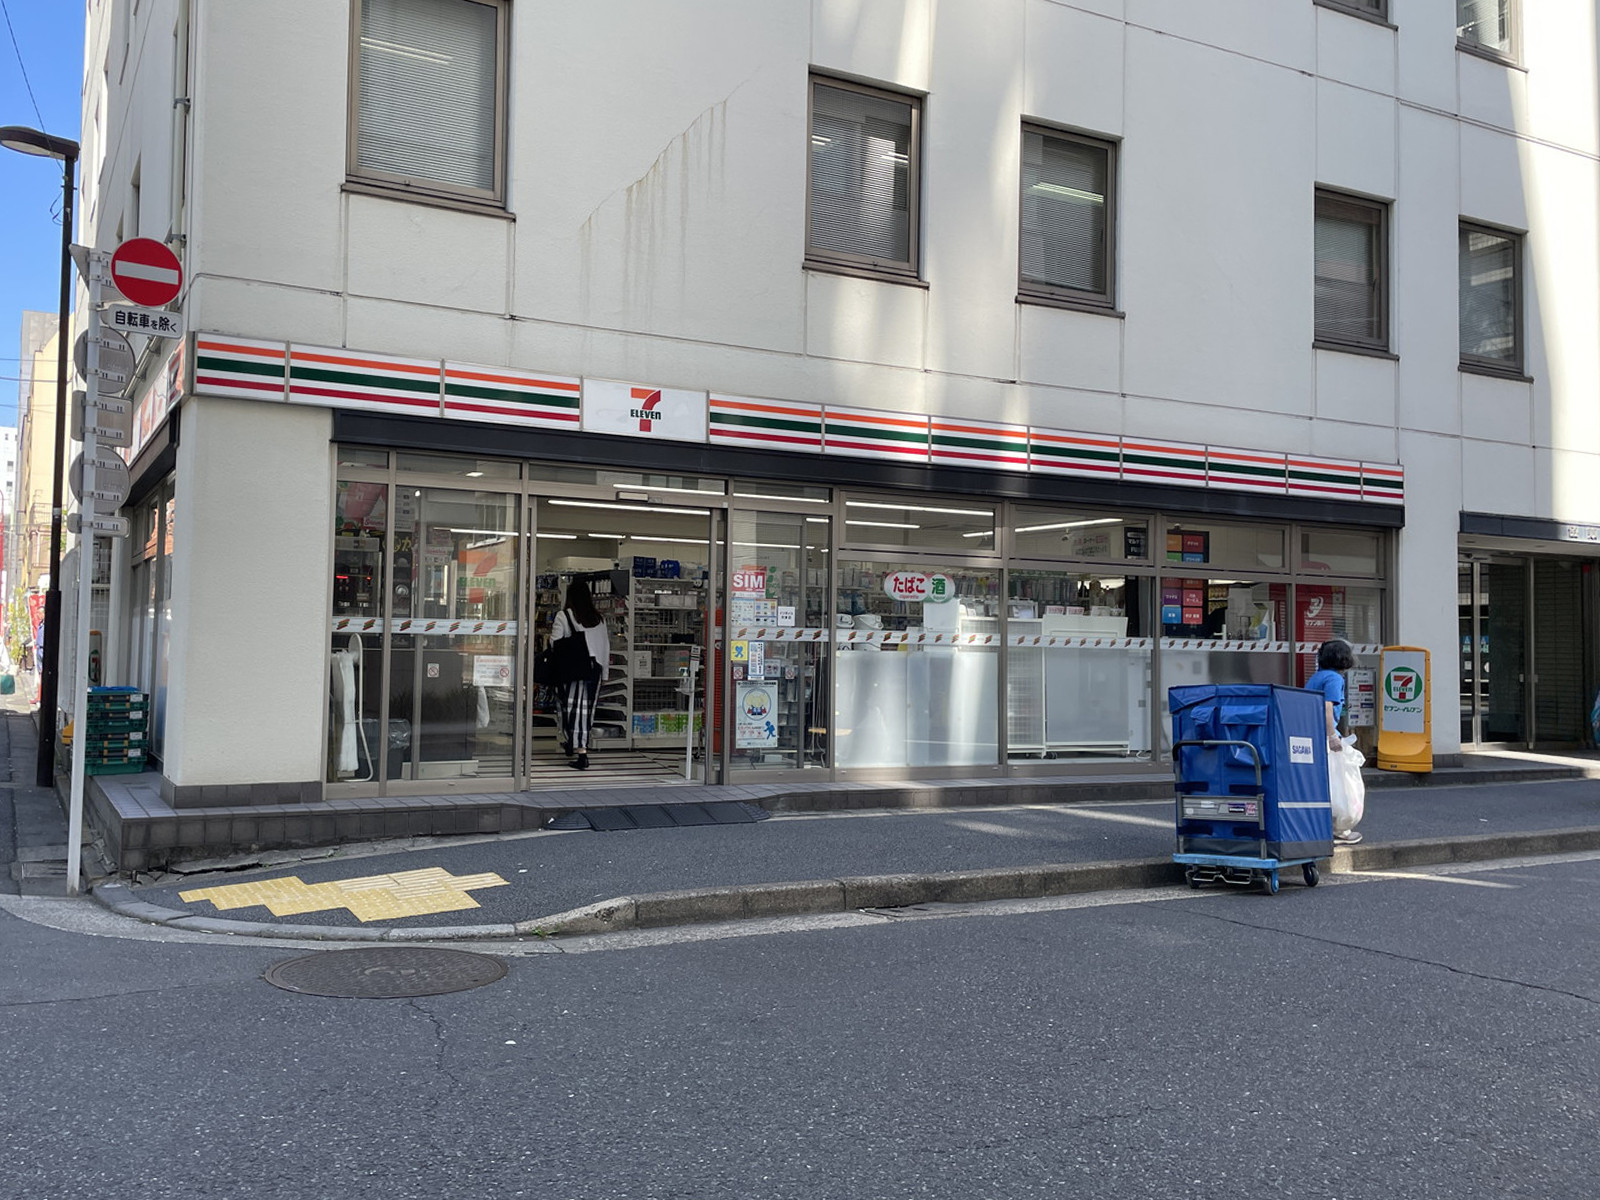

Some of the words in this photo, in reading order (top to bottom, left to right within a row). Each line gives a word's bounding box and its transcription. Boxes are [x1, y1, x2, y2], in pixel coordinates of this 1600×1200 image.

[115, 311, 177, 333] 自転車を除く
[631, 387, 661, 432] 7
[732, 574, 763, 588] SIM
[893, 576, 925, 593] たばこ
[931, 578, 946, 594] 酒
[1394, 675, 1413, 699] 7
[1291, 745, 1311, 754] SAGAWA
